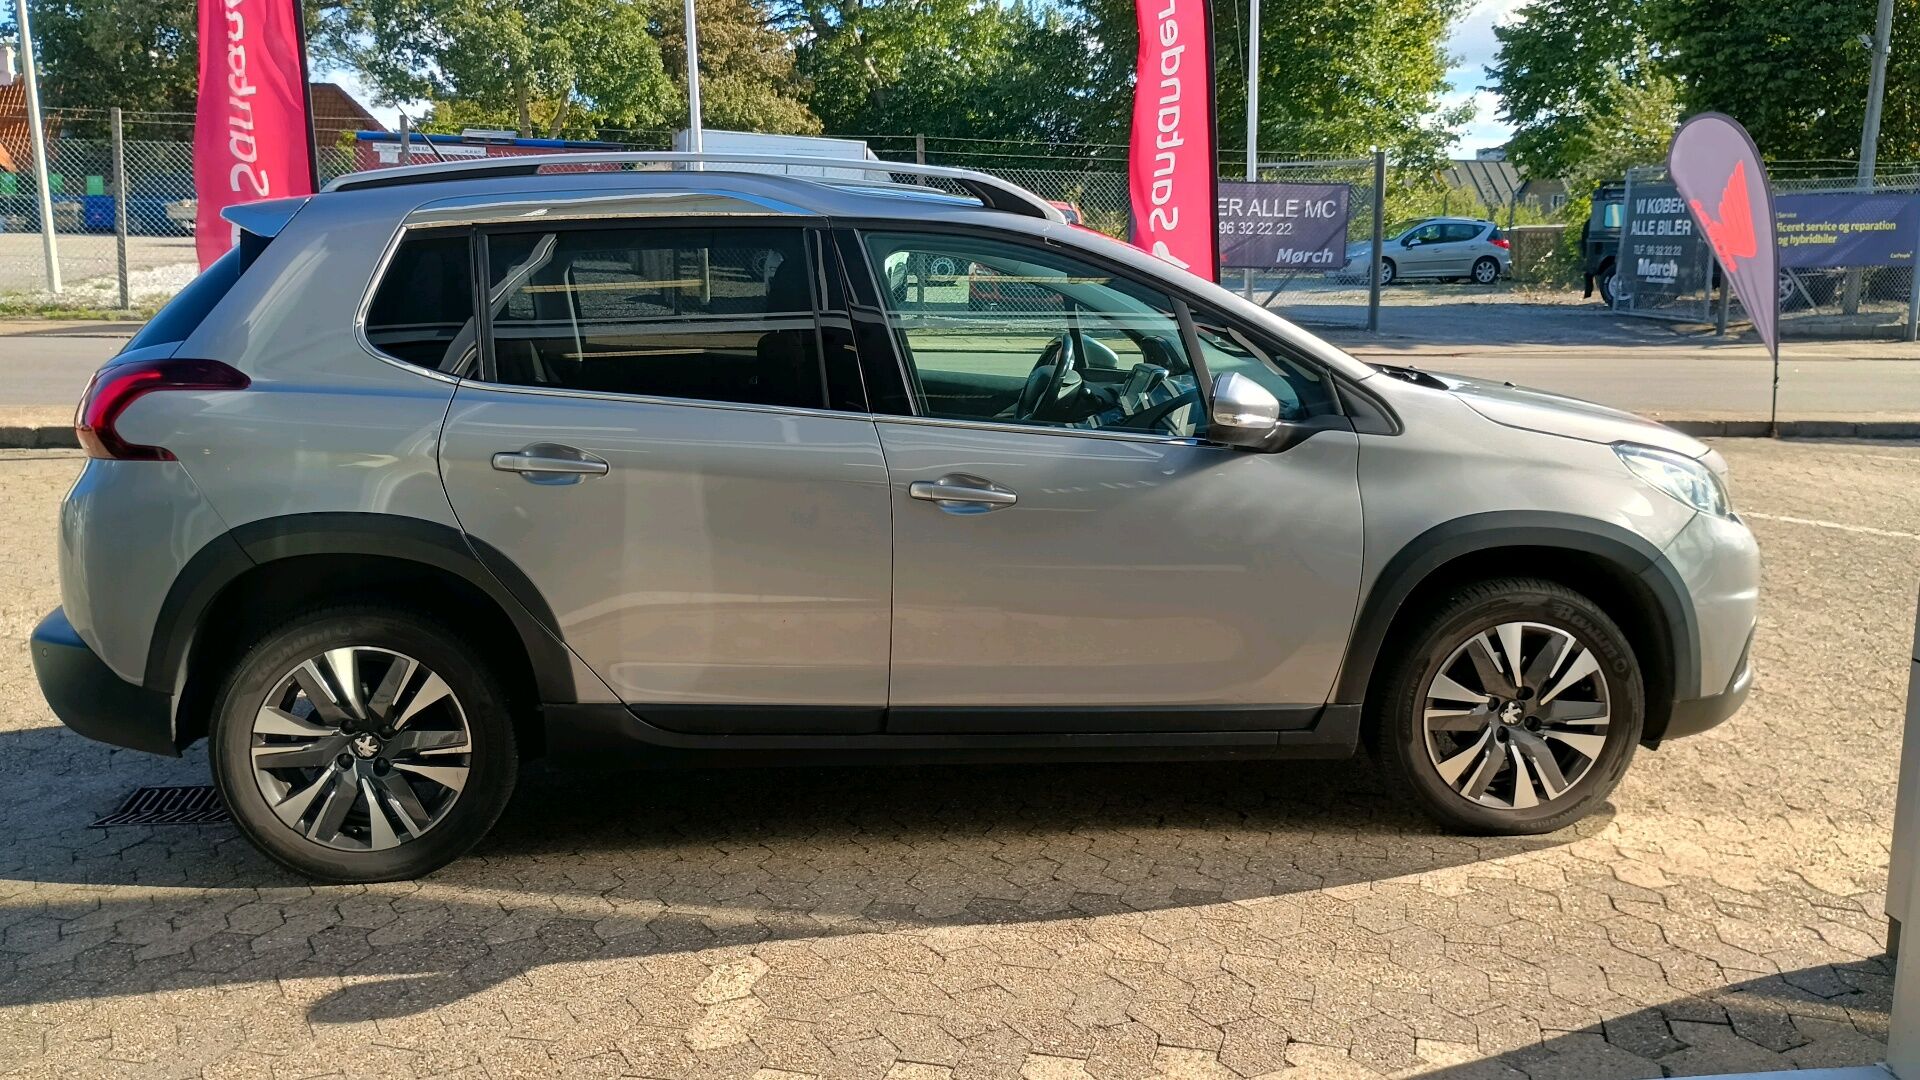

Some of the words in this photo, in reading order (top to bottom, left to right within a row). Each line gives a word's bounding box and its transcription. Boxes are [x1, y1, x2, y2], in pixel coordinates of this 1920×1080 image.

[1246, 198, 1299, 218] ALLE
[1304, 199, 1336, 218] MC
[1636, 198, 1645, 214] VI
[1219, 221, 1234, 235] 96
[1238, 222, 1253, 235] 32
[1256, 222, 1273, 235] 22
[1275, 222, 1292, 236] 22
[1630, 220, 1656, 236] ALLE
[1656, 220, 1692, 236] BILER
[1806, 221, 1837, 232] service
[1838, 223, 1850, 233] og
[1851, 220, 1896, 232] reparation
[1789, 234, 1837, 246] hybridbiler
[1276, 247, 1333, 265] Mørch
[1637, 258, 1679, 277] Mørch
